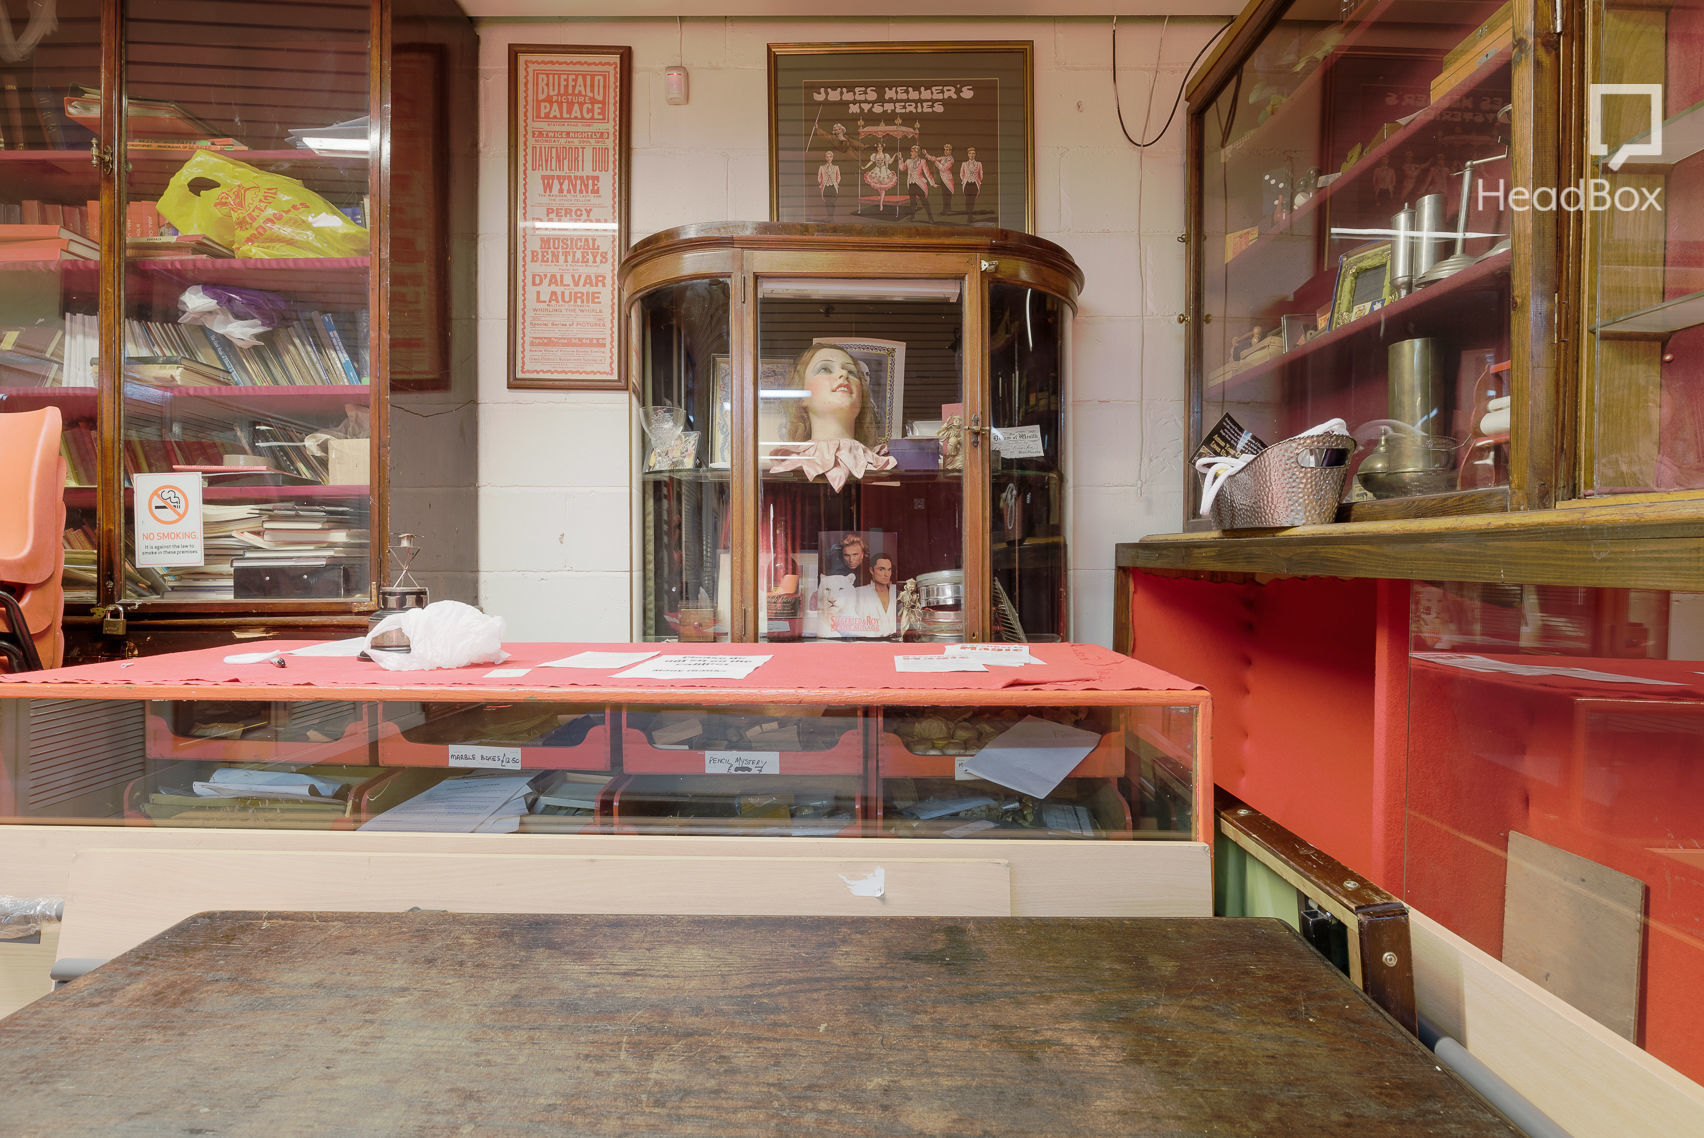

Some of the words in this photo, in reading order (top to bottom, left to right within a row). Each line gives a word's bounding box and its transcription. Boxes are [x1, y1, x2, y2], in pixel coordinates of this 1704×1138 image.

[537, 74, 604, 100] BUFFALO
[813, 86, 877, 101] JULES
[884, 84, 974, 101] HELLER'S
[552, 95, 591, 103] PICTURE
[540, 102, 603, 119] PALACE
[849, 102, 944, 114] MYSTERIES
[531, 146, 586, 172] DAVENPORT
[592, 147, 610, 173] DUO
[540, 174, 600, 194] WYNNE
[545, 207, 593, 218] PERCY
[539, 237, 600, 250] MUSICAL
[530, 250, 608, 265] BENTLEYS
[531, 273, 607, 288] D'ALVAR
[535, 290, 602, 305] LAURIE
[142, 532, 155, 541] NO
[450, 753, 476, 761] MARBLE
[709, 756, 731, 765] PENCIL
